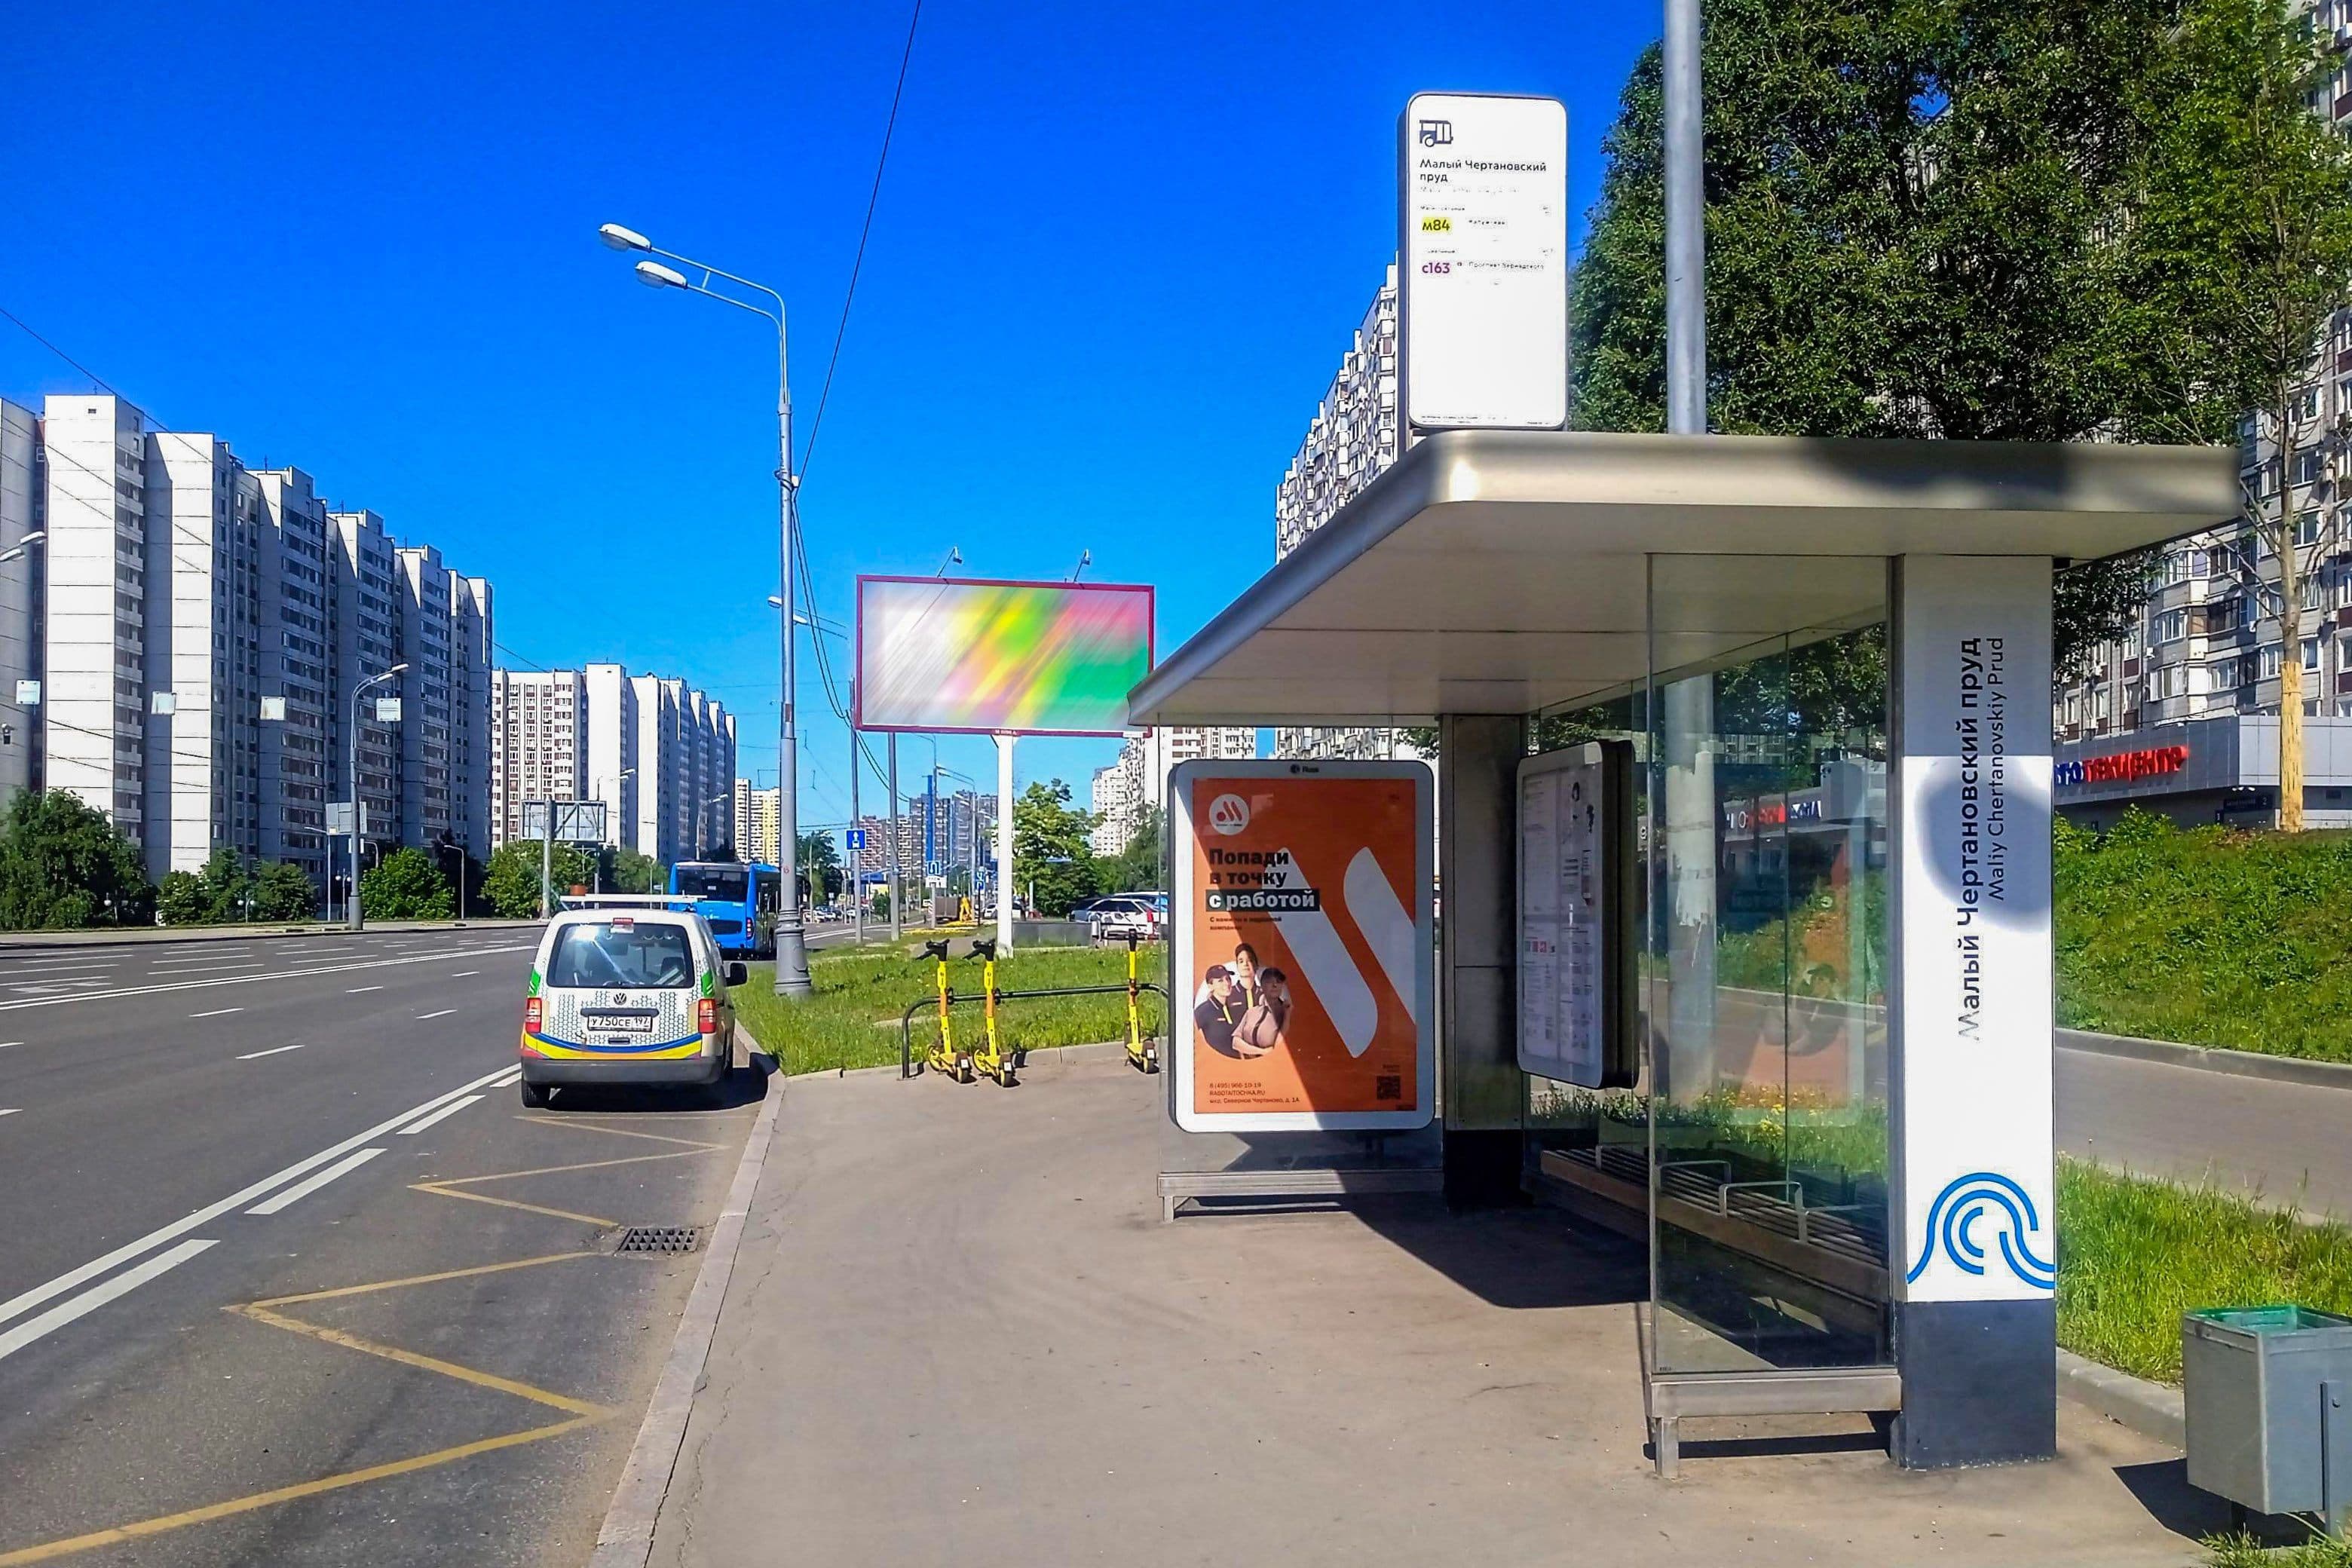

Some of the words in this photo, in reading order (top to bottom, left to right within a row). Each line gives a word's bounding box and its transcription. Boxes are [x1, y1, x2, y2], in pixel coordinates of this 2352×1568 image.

[1419, 158, 1462, 169] Малый
[1465, 160, 1547, 172] Чертановский
[1419, 173, 1448, 183] пруд
[1422, 262, 1450, 274] с163
[1961, 638, 1983, 708] пруд
[1986, 638, 2004, 684] Prud
[1986, 691, 2007, 836] Chertanovskiy
[1955, 718, 1984, 926] Чертановский
[1209, 848, 1289, 868] Попади
[1987, 842, 2007, 901] Maliy
[1210, 872, 1221, 884] в
[1227, 871, 1288, 888] точку
[1209, 894, 1221, 908] с
[1227, 889, 1315, 911] работой
[1957, 936, 1980, 1041] Малый
